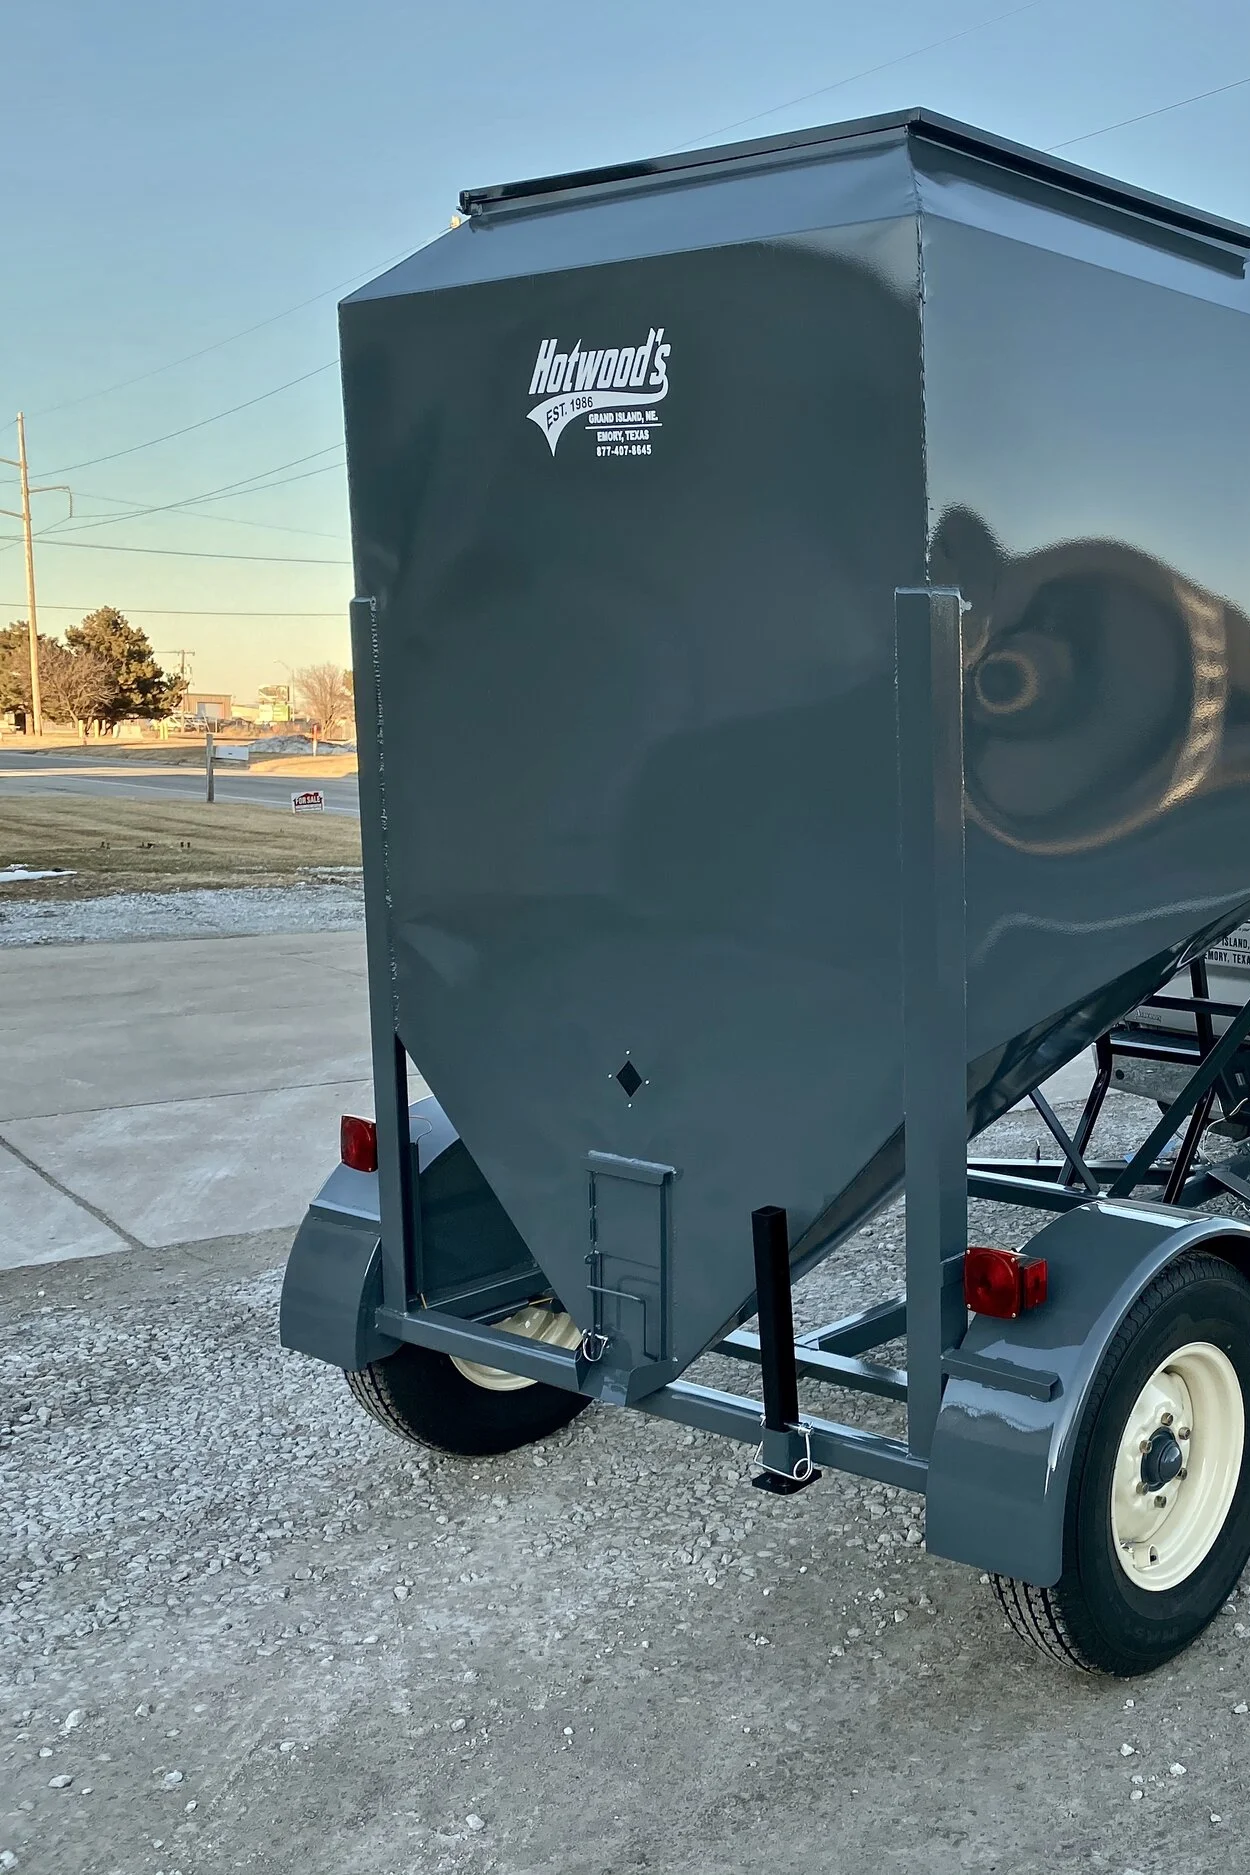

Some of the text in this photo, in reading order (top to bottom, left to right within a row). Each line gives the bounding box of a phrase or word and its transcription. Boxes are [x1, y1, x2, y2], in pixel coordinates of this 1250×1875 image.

[528, 327, 671, 394] Hotwood's
[546, 396, 593, 431] EST. 1986
[588, 410, 658, 424] GRAND ISLAND, NE.
[597, 430, 650, 443] EMORY, TEXAS
[596, 444, 652, 457] 877-407-8645
[296, 795, 320, 805] FOR SALE
